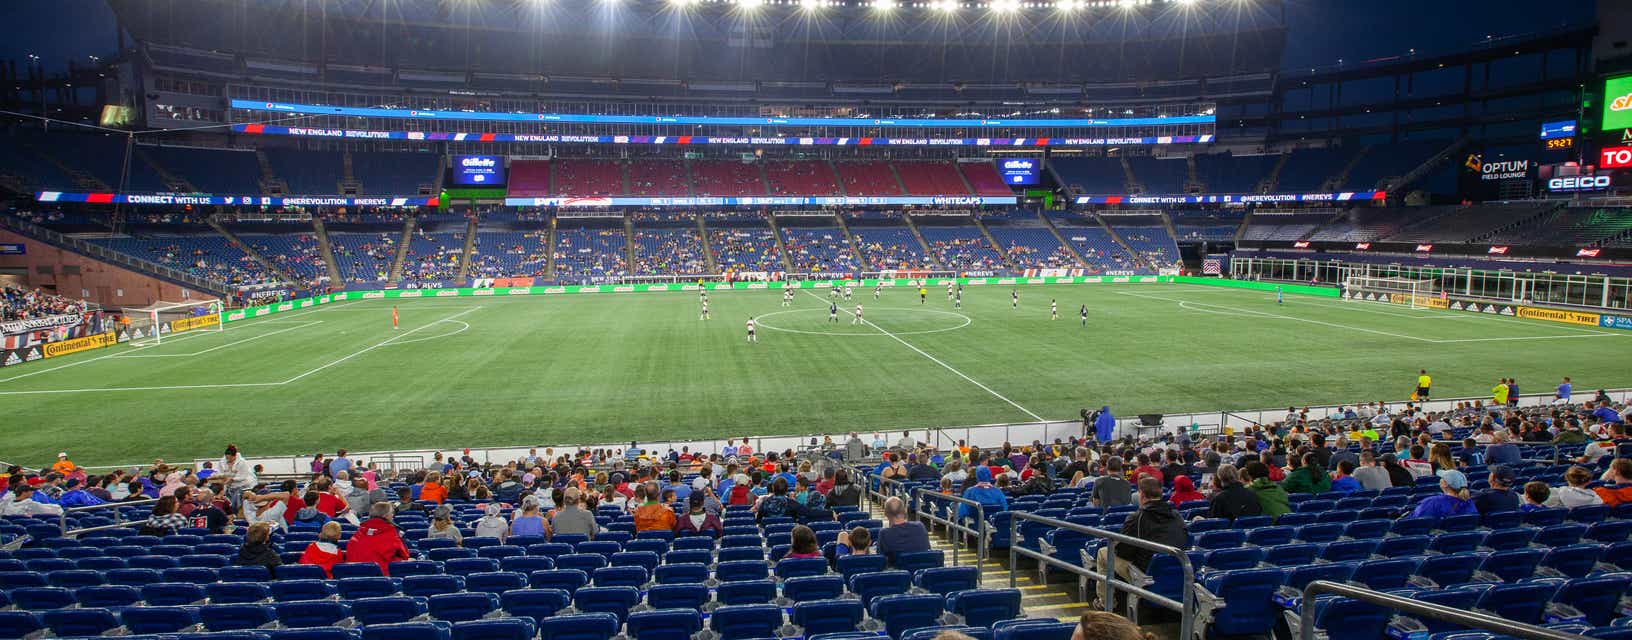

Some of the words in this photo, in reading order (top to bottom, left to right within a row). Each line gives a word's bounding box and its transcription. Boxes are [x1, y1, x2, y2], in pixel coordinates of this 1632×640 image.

[289, 127, 306, 135] NEW
[308, 129, 342, 137] ENGLAND
[346, 130, 390, 138] REVOLUTION
[1483, 159, 1529, 173] OPTUM
[1500, 171, 1526, 179] LOUNGE
[1549, 175, 1611, 189] GEICO
[128, 195, 172, 204] CONNECT
[175, 196, 198, 204] WITH
[282, 198, 348, 206] @NEREVOLUTION
[934, 197, 981, 205] WHITECAPS
[1241, 194, 1296, 202] @NEREVOLUTION
[1519, 306, 1567, 320] Continental
[1577, 314, 1597, 324] TIRE
[46, 337, 91, 356] Continental
